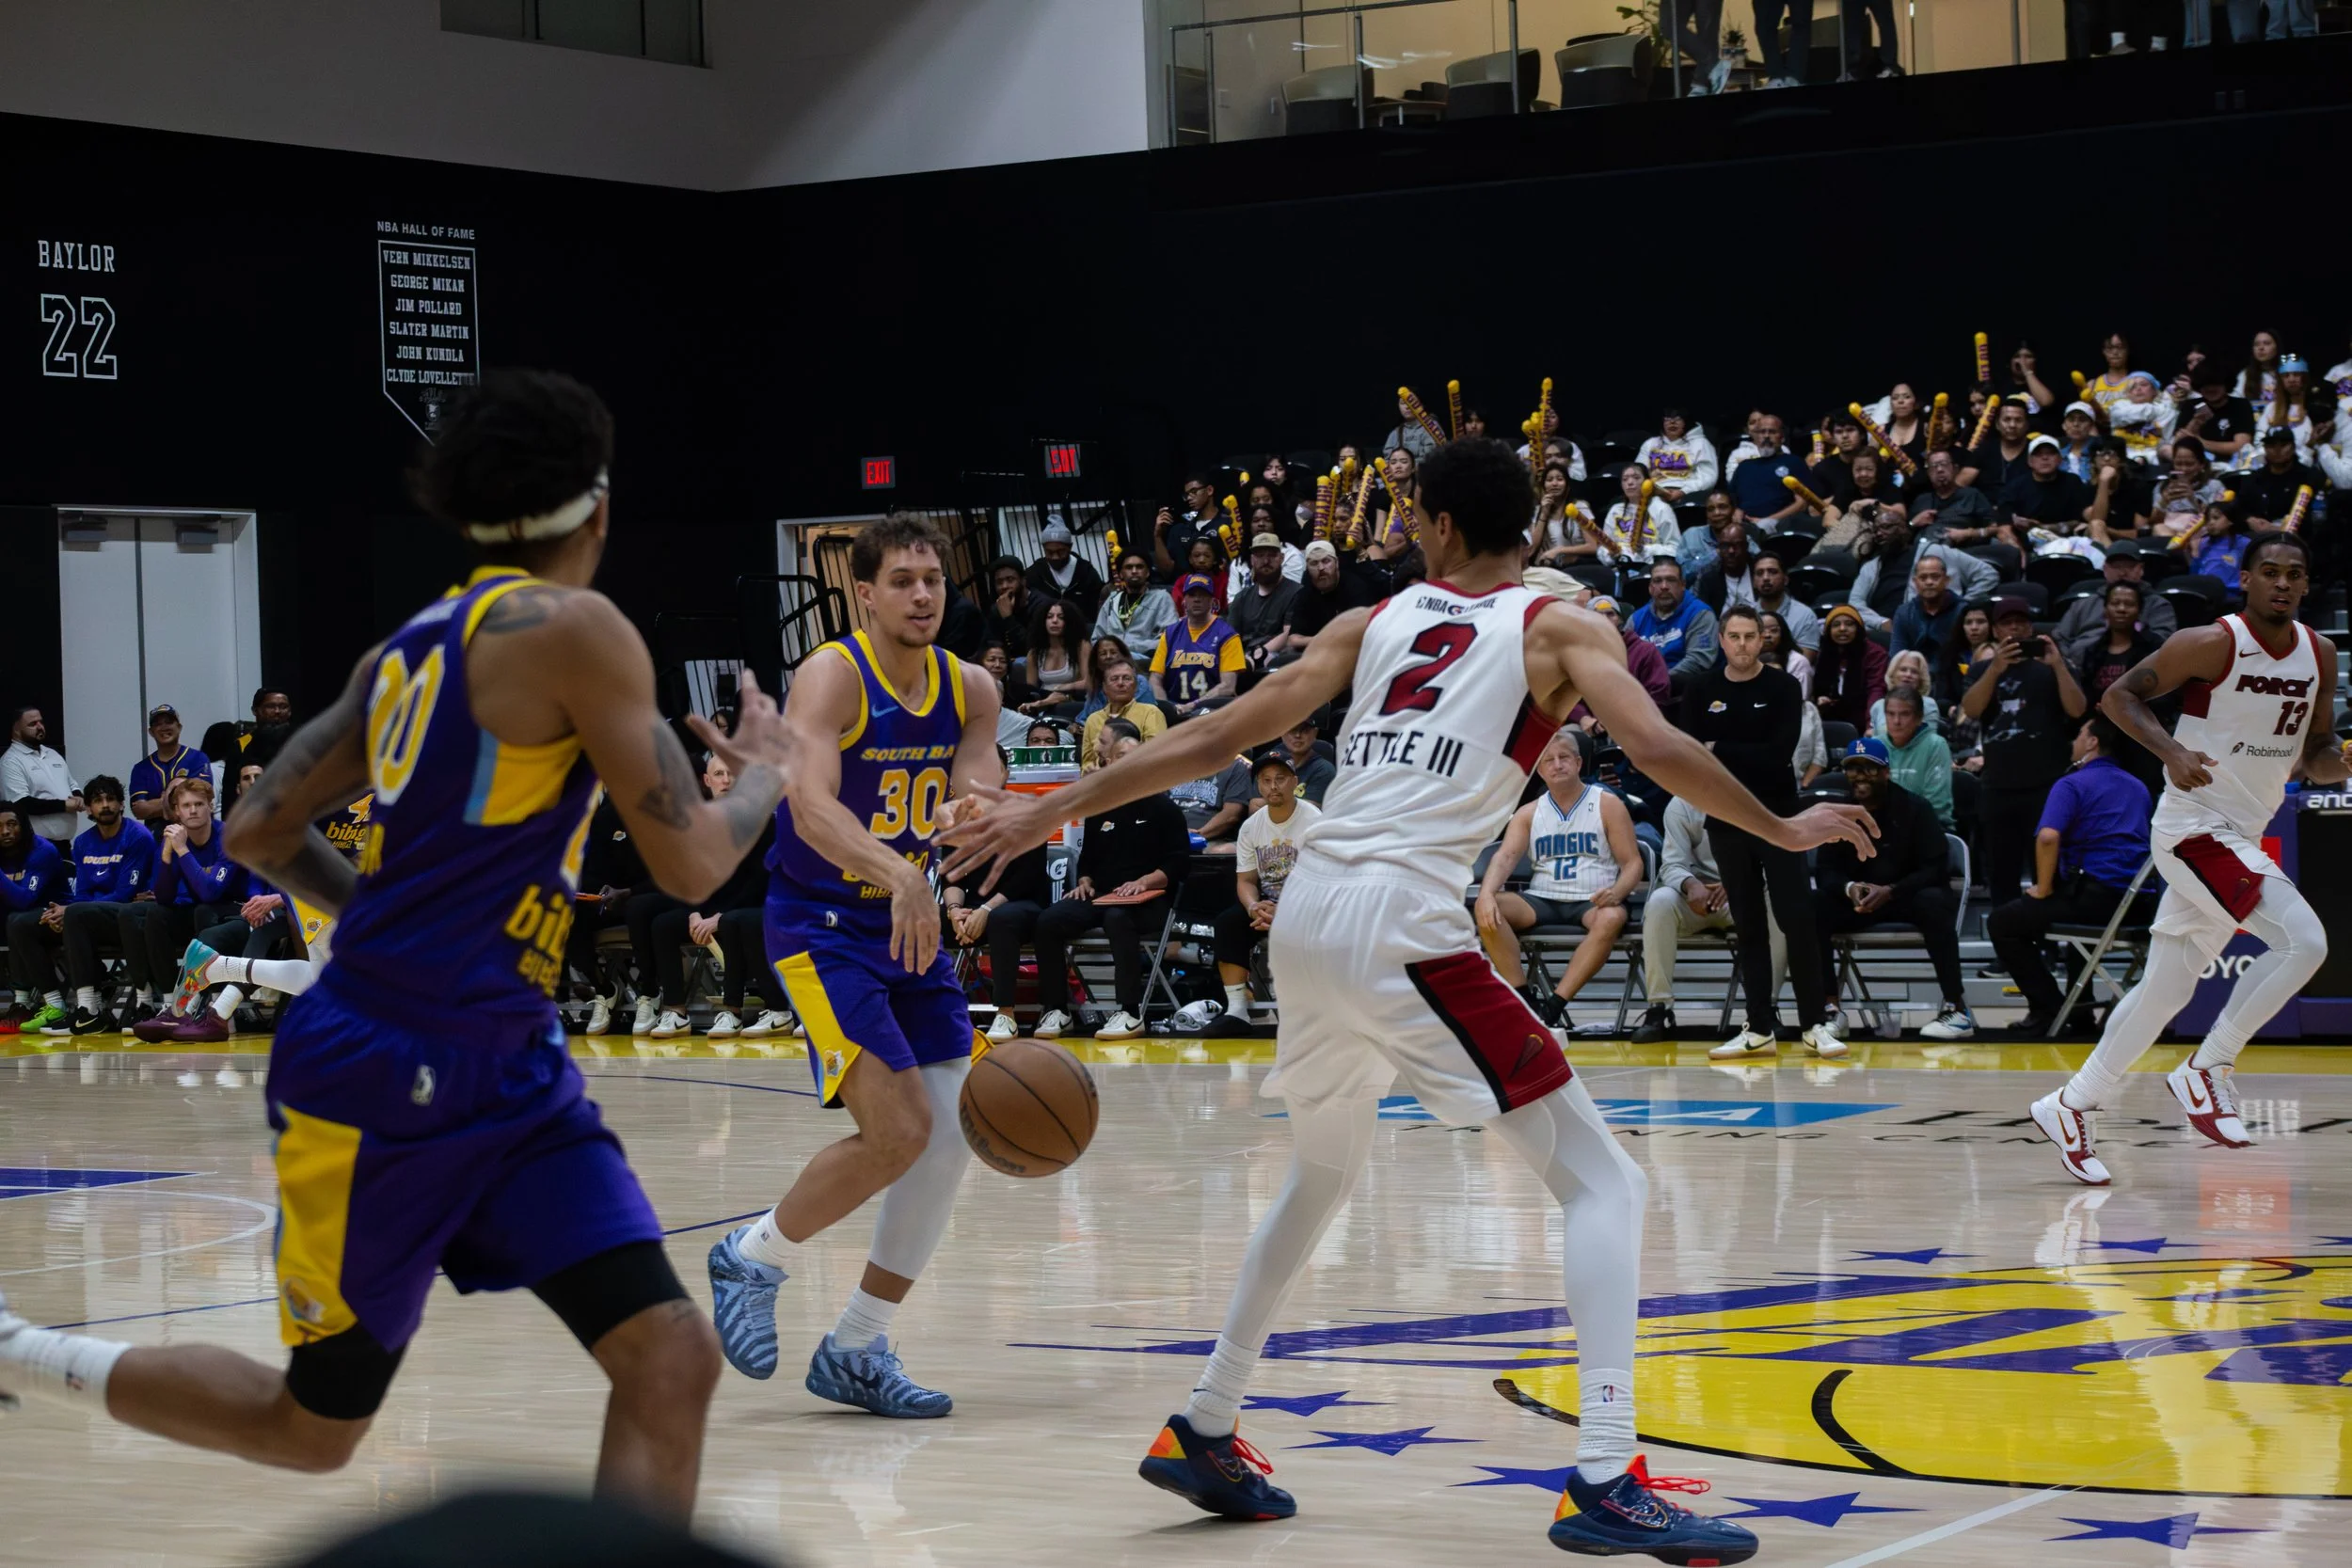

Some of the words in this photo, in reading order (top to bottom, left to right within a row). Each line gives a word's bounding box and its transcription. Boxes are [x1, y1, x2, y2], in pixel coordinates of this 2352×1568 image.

[377, 221, 399, 233] NBA
[402, 223, 428, 236] HALL
[431, 226, 444, 237] OF
[448, 228, 475, 240] FAME
[38, 239, 115, 273] BAYLOR
[383, 249, 409, 264] VERN
[413, 252, 471, 270] MIKKELSEN
[390, 275, 429, 291] GEORGE
[433, 277, 465, 293] MIKAN
[395, 298, 415, 312] JIM
[419, 299, 462, 315] POLLARD
[40, 293, 118, 380] 22
[389, 321, 427, 337] SLATER
[431, 324, 469, 340] MARTIN
[396, 345, 422, 360] JOHN
[425, 347, 465, 362] KUNDLA
[387, 368, 416, 384] CLYDE
[866, 460, 891, 484] EXIT
[1050, 447, 1076, 474] EXIT
[1424, 596, 1449, 613] NBA
[1171, 649, 1216, 668] LAKERS
[1378, 622, 1478, 716] 2
[1180, 670, 1208, 700] 14
[2235, 674, 2312, 698] FORCE
[2273, 701, 2309, 736] 13
[861, 747, 926, 762] SOUTH
[927, 744, 956, 759] BA
[1427, 736, 1464, 778] III
[870, 767, 949, 840] 30
[326, 820, 369, 842] bibig
[1534, 832, 1600, 861] MAGIC
[1554, 855, 1579, 881] 12
